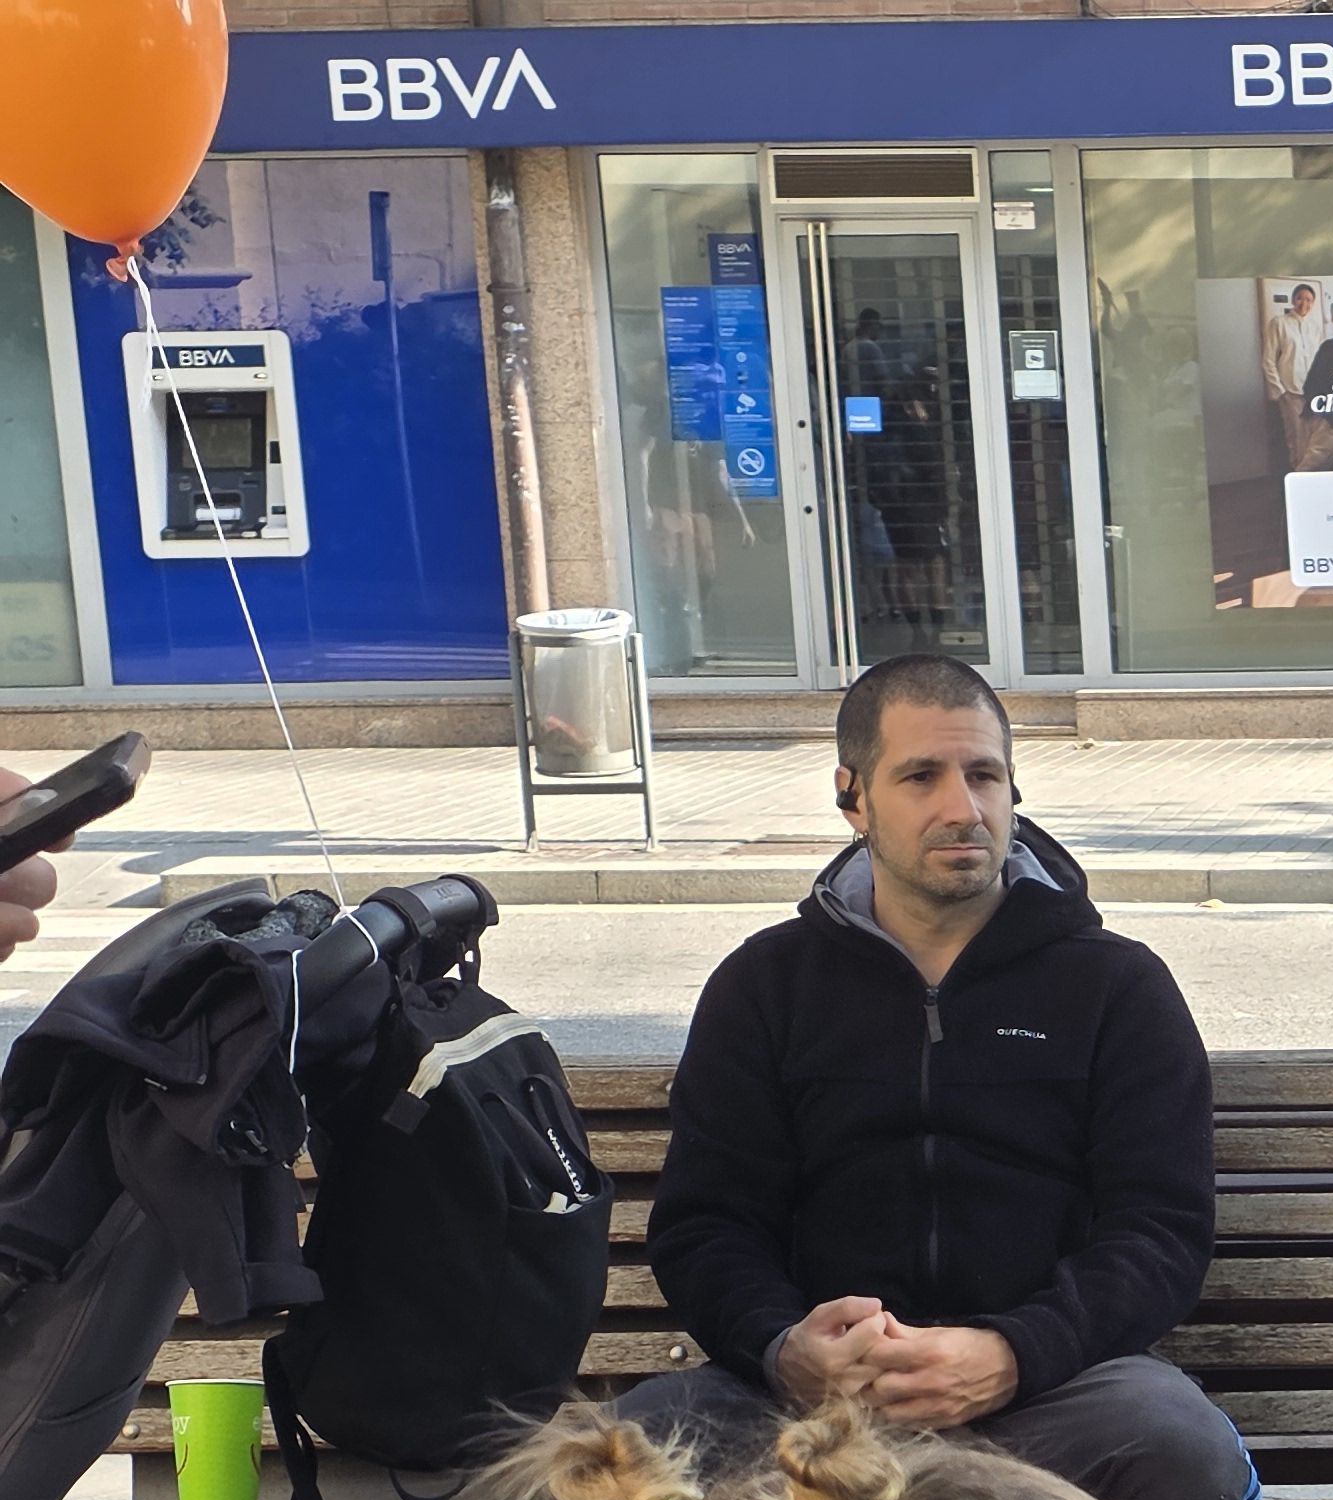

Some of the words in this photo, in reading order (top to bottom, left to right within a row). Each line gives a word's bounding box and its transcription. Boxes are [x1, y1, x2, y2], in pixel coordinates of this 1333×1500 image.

[328, 48, 557, 121] BBVA
[717, 243, 752, 255] BBVA
[178, 348, 236, 367] BBVA
